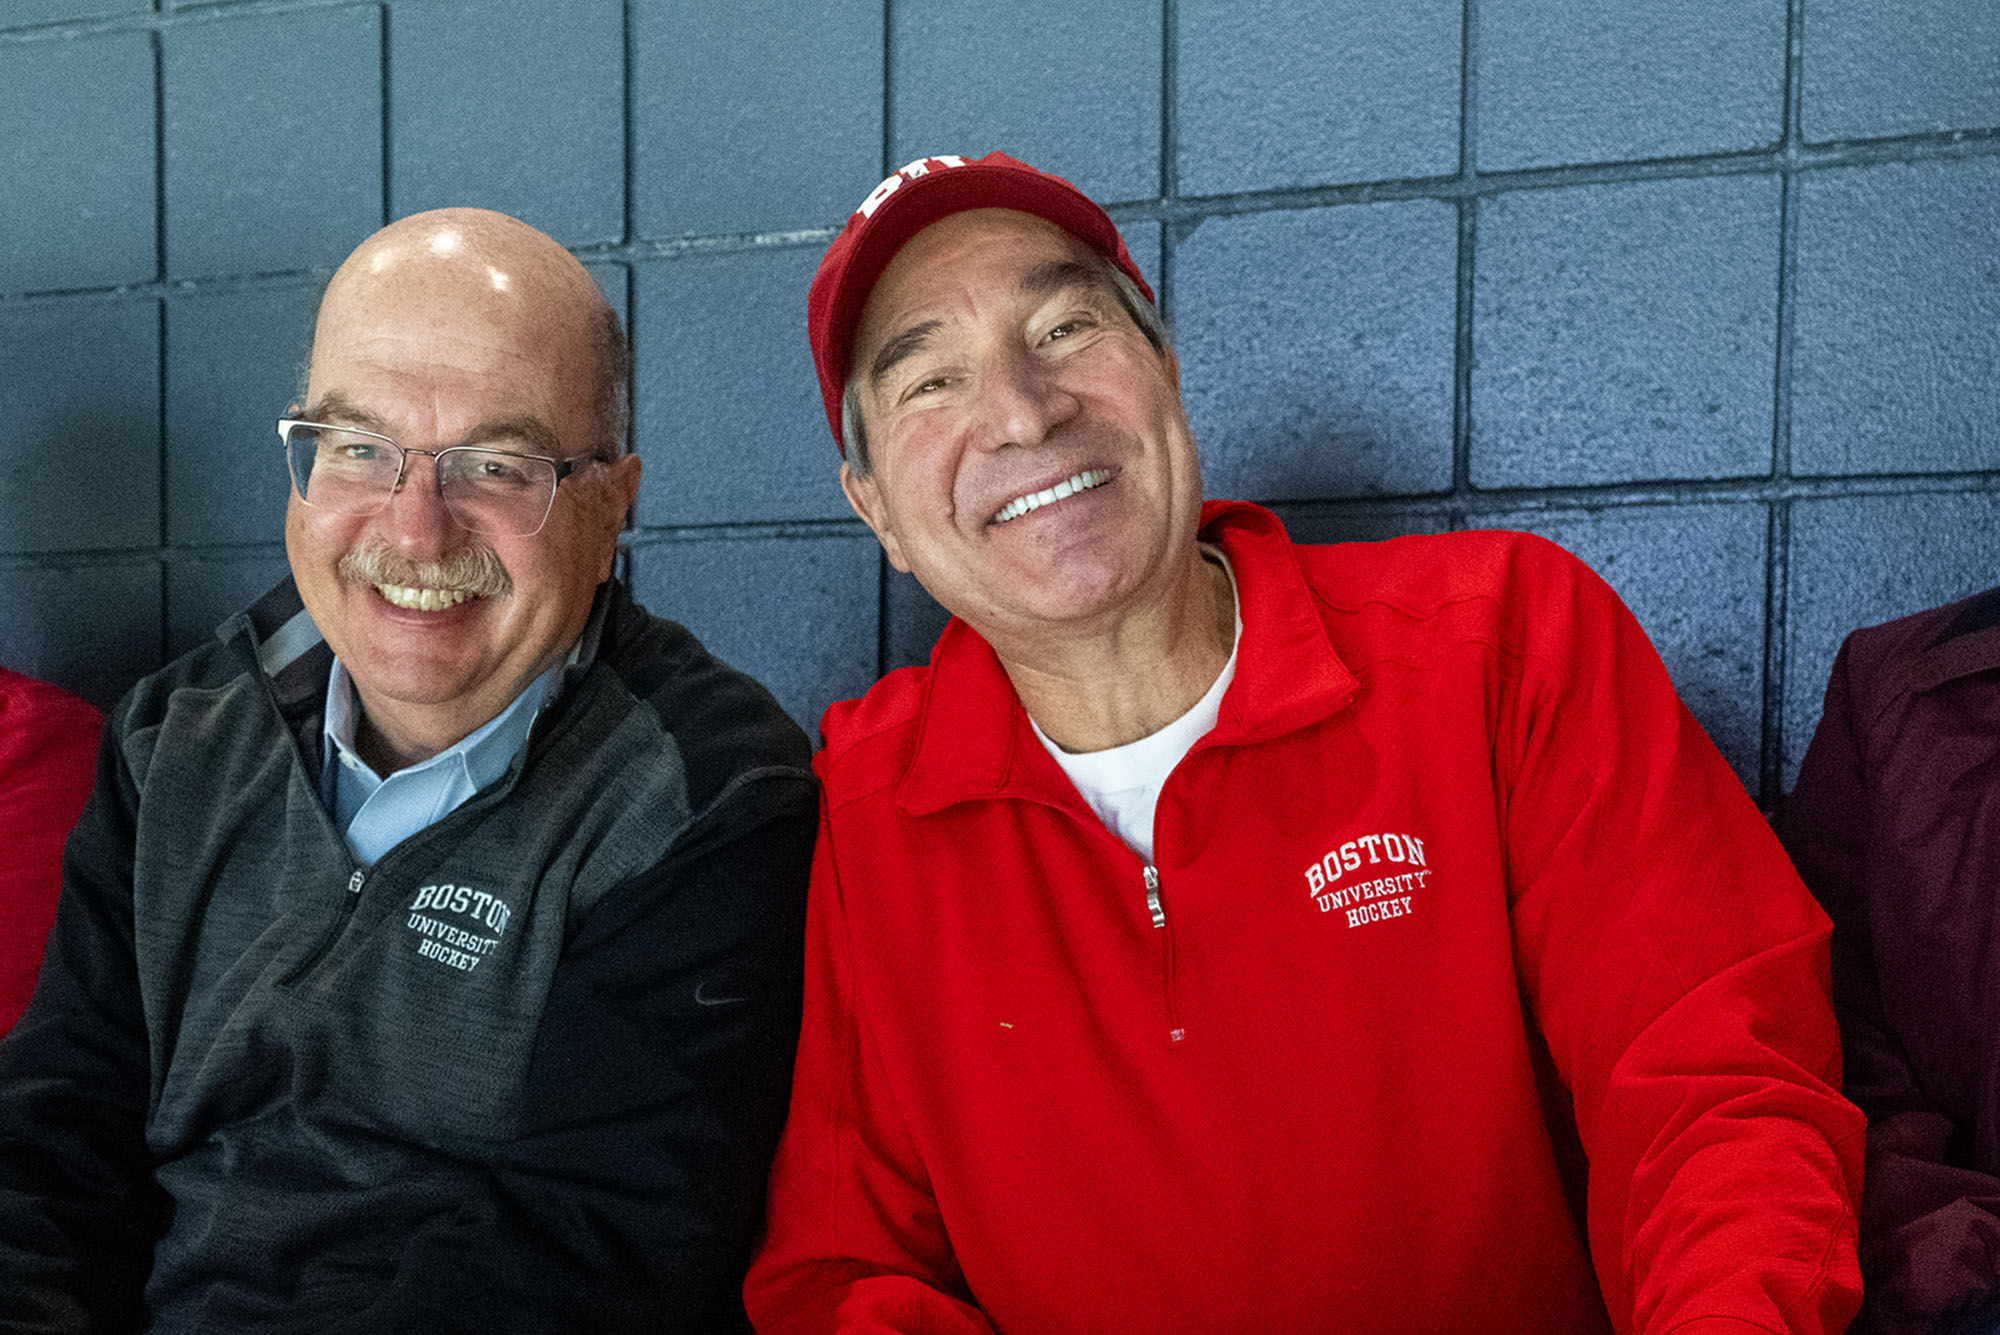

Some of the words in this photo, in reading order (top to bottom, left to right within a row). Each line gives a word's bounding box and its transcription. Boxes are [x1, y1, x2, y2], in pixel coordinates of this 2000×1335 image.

[1304, 833, 1427, 898] BOSTON
[409, 884, 511, 936] BOSTON
[1316, 871, 1427, 912] UNIVERSITY
[1345, 896, 1412, 928] HOCKEY
[418, 938, 480, 972] HOCKEY
